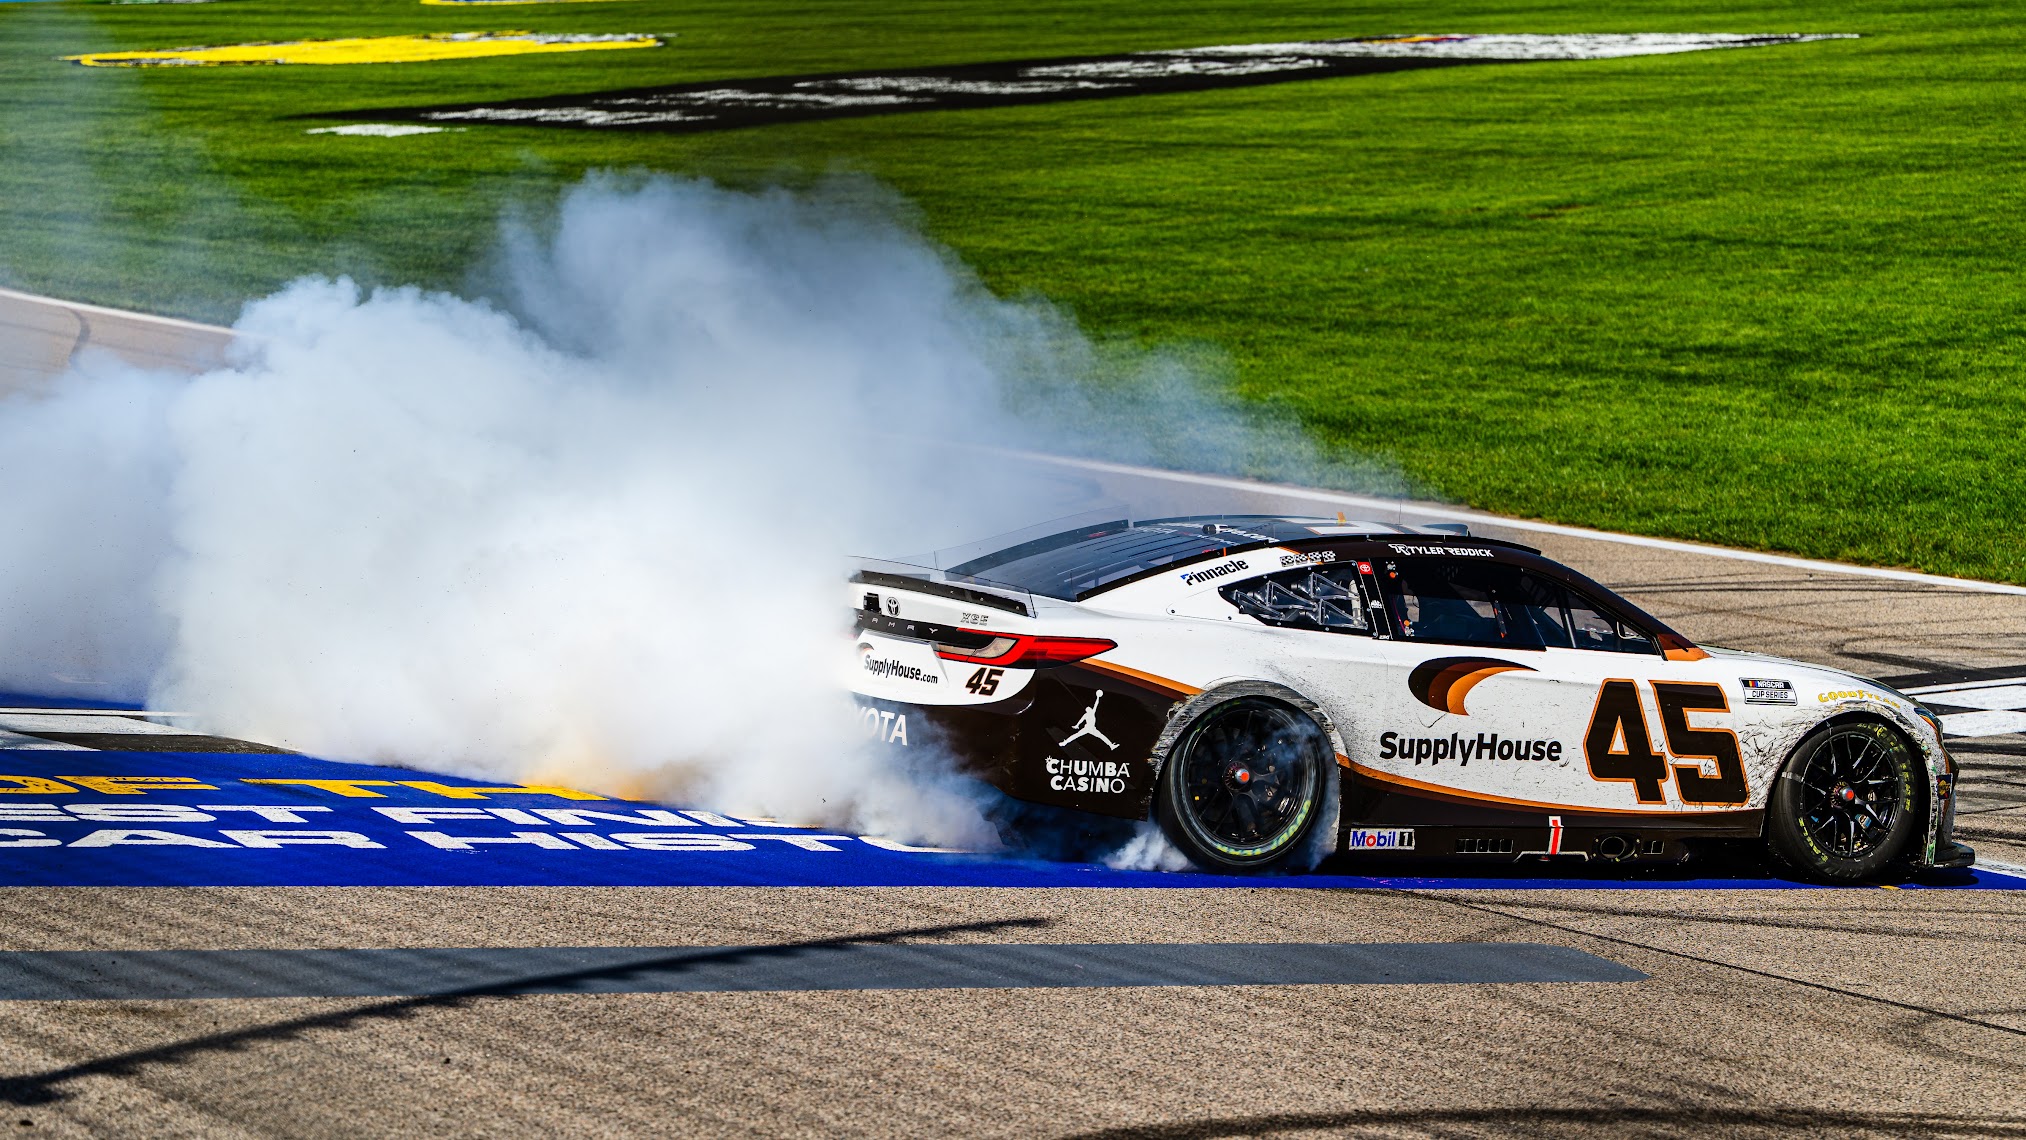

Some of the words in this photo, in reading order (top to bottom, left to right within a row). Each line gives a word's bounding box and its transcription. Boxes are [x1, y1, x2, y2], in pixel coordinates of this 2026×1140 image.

[1408, 546, 1445, 555] TYLER
[1444, 547, 1494, 557] REDDICK
[1180, 559, 1249, 586] Pinnacle
[960, 612, 989, 627] XSE
[863, 654, 938, 684] SupplyHouse.com
[965, 667, 1005, 696] 45
[1757, 680, 1785, 689] NASCAR
[1751, 690, 1765, 698] CUP
[1766, 691, 1788, 699] SERIES
[1380, 731, 1562, 767] SupplyHouse
[1583, 678, 1749, 806] 45
[1045, 755, 1130, 777] CHUMBA
[1050, 775, 1126, 794] CASINO
[1350, 830, 1396, 847] Mobil
[1401, 831, 1412, 846] 1
